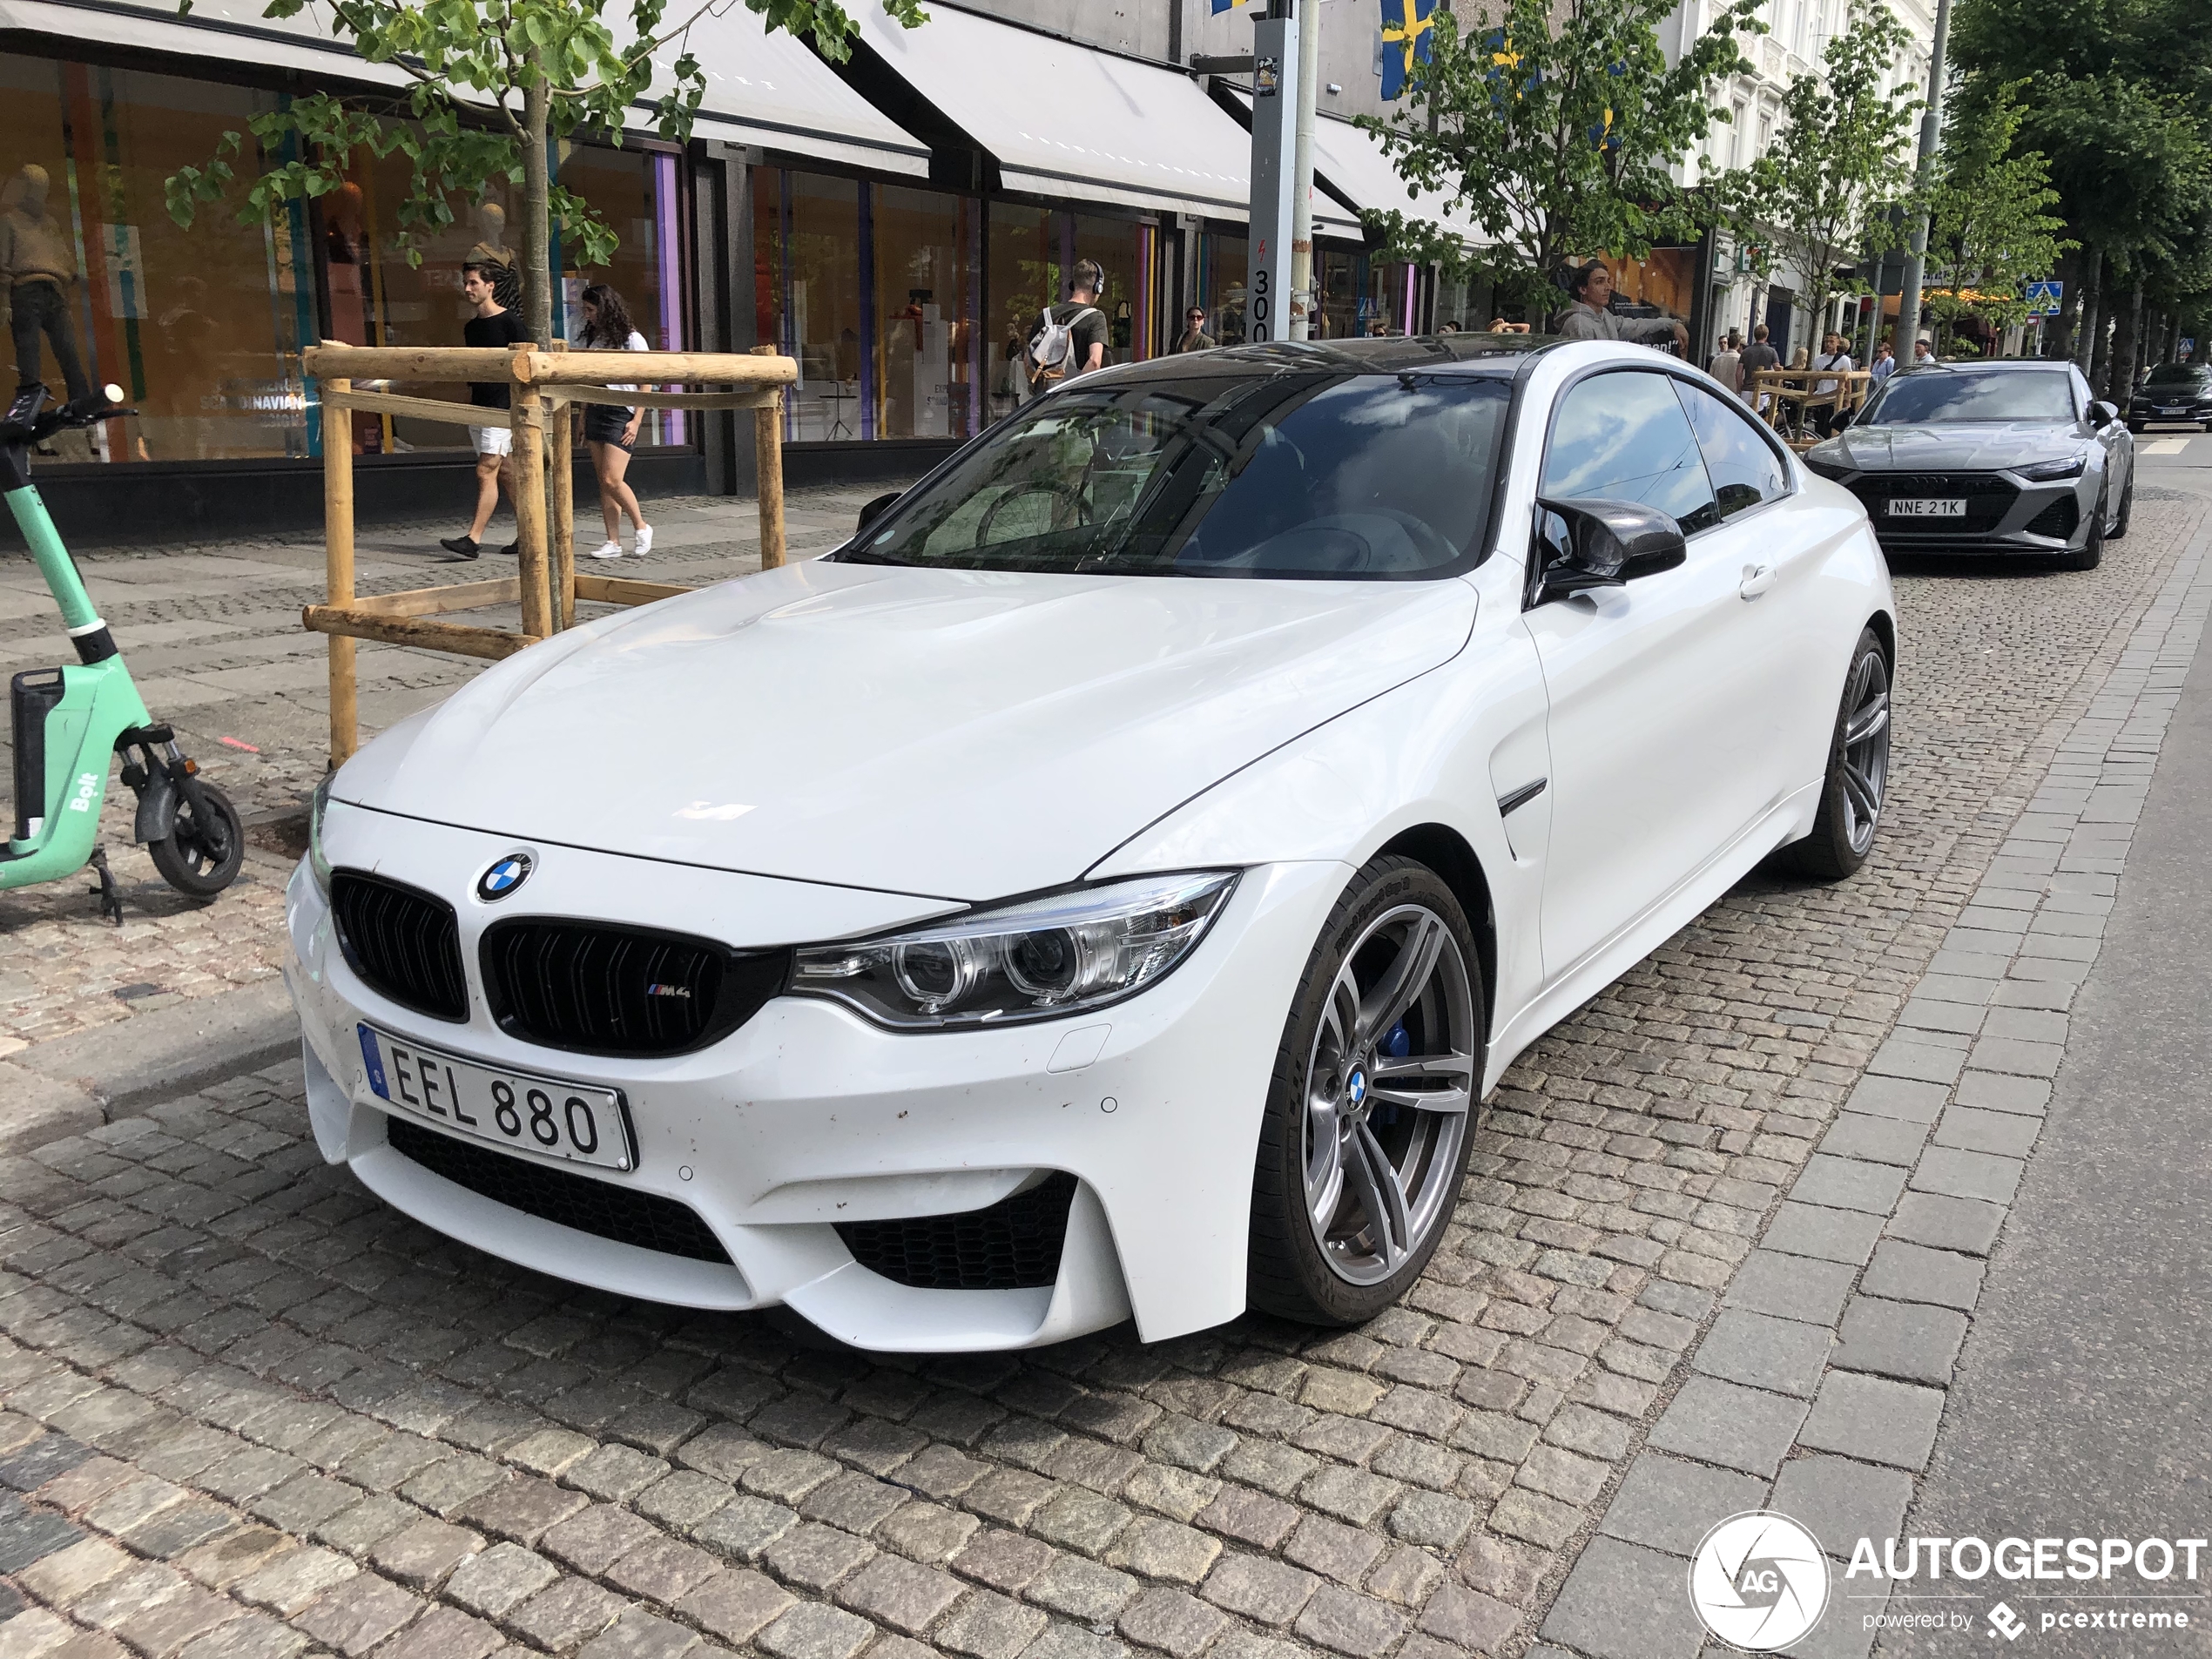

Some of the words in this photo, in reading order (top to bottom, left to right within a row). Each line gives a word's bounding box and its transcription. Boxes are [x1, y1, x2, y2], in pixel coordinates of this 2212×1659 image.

[1894, 501, 1924, 514] NNE
[1928, 501, 1959, 514] 21K
[70, 772, 99, 813] Bolt
[659, 984, 691, 998] M4
[391, 1046, 478, 1127] EEL
[490, 1079, 599, 1155] 880
